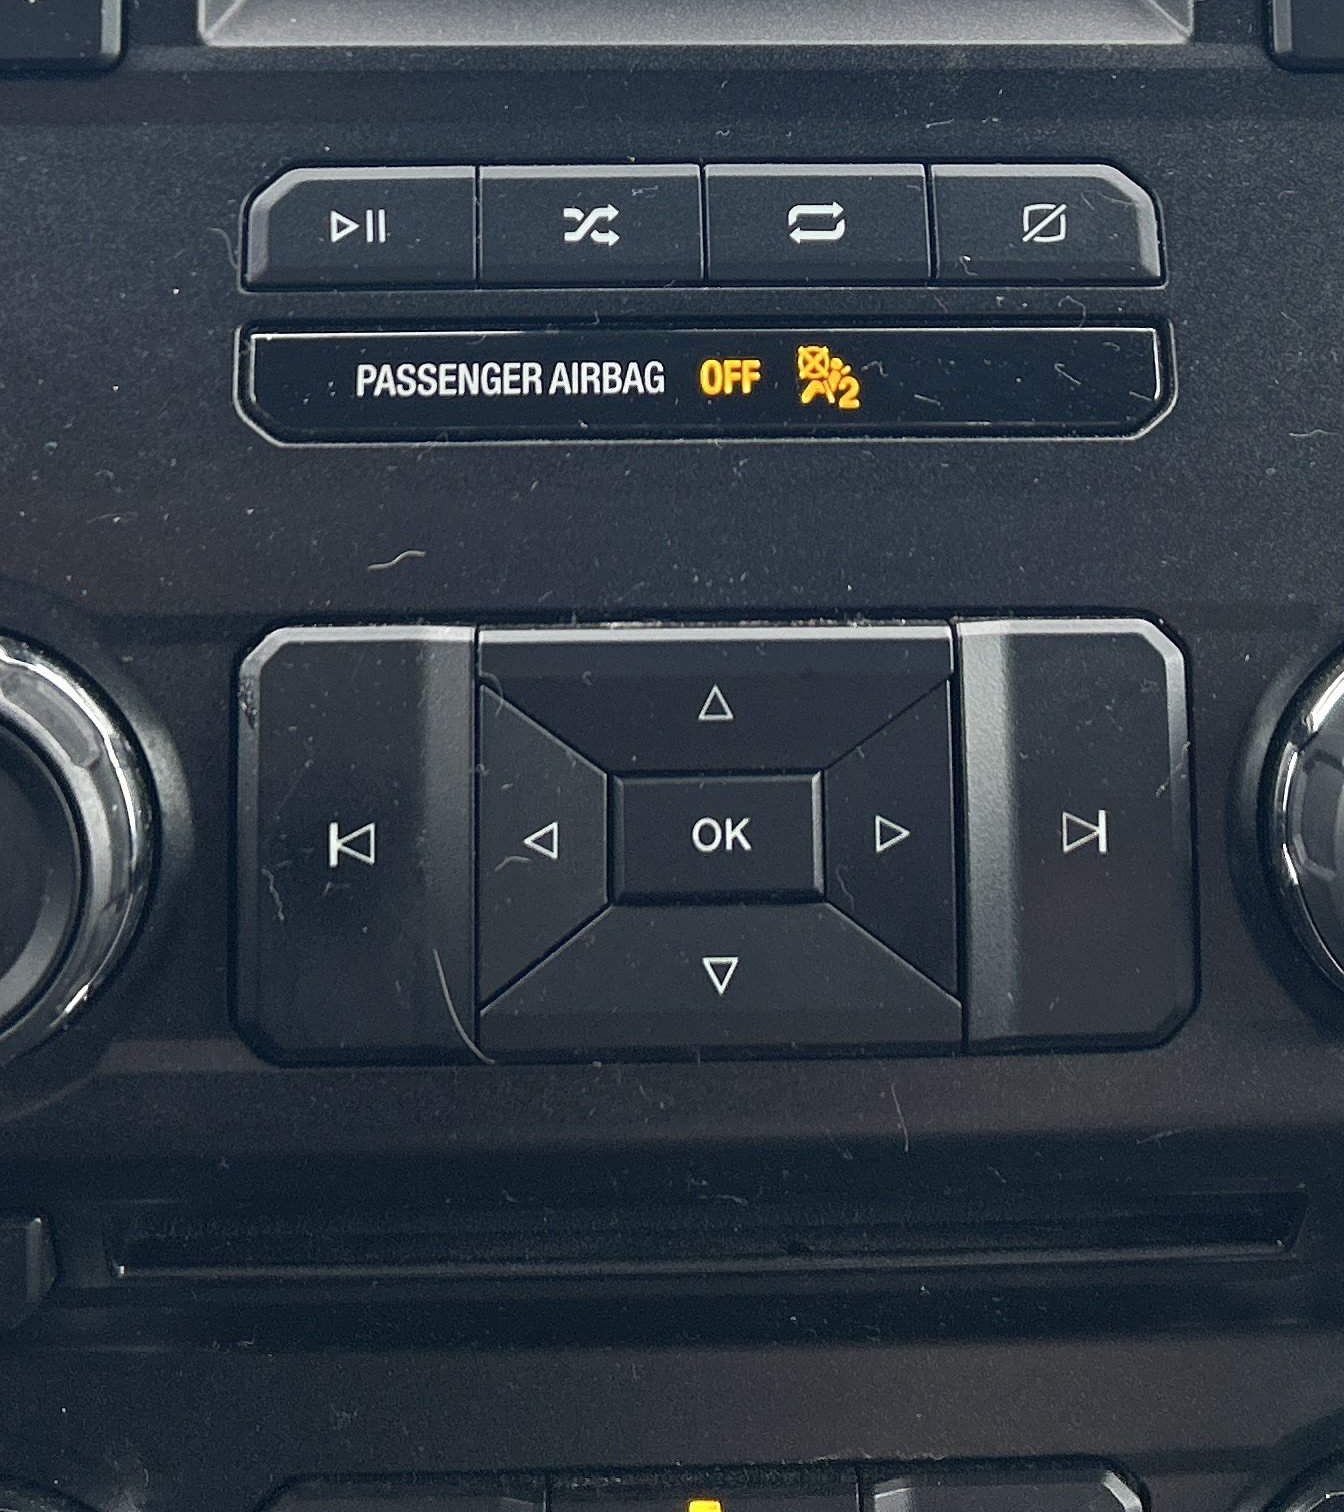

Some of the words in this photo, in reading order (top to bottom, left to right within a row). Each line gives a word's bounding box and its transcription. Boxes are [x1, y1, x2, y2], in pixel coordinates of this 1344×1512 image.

[356, 361, 544, 397] PASSENGER
[548, 360, 666, 395] AIRBAG
[699, 359, 762, 396] OFF
[691, 817, 752, 853] OK
